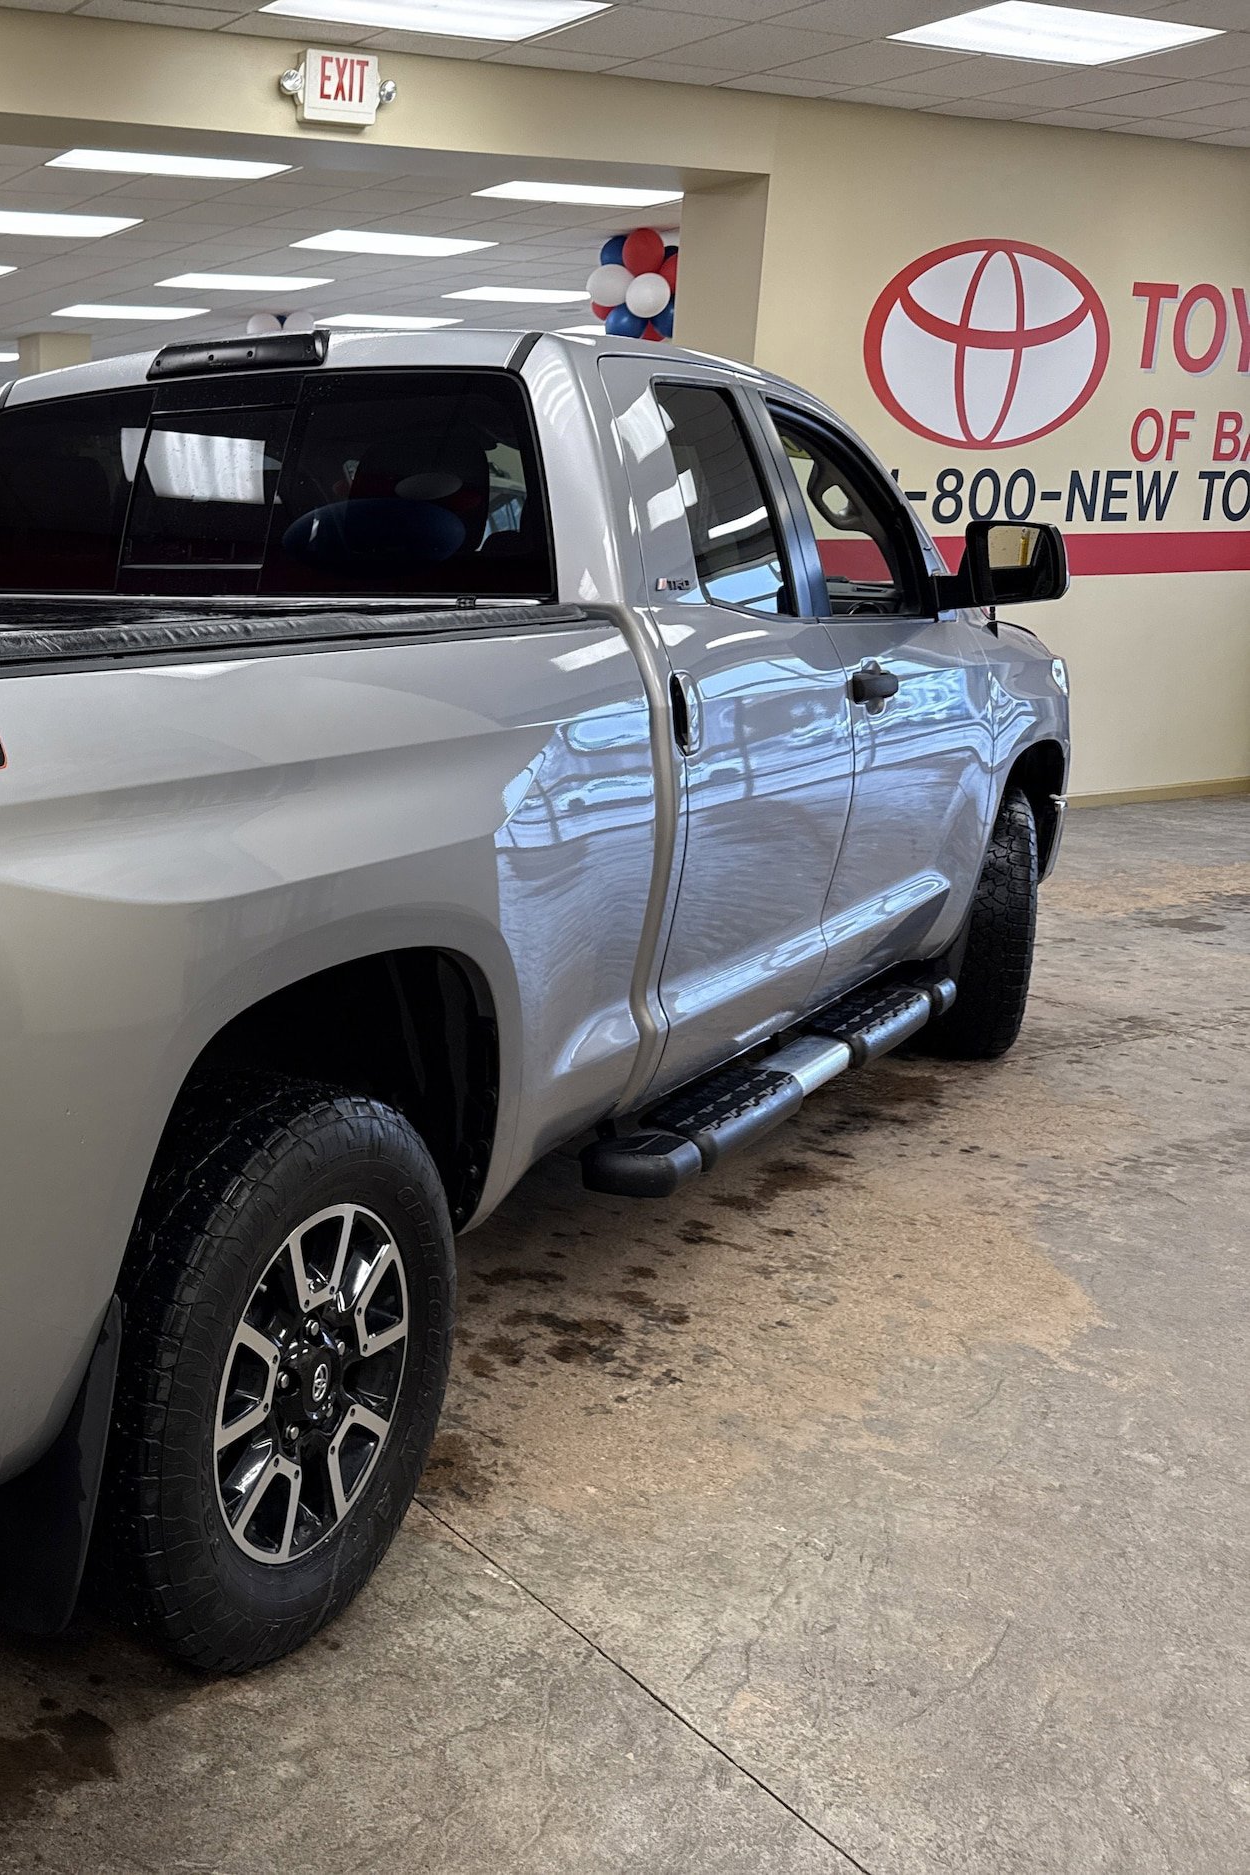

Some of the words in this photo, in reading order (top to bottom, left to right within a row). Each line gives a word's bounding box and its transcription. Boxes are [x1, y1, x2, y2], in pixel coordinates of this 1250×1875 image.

[319, 55, 369, 103] EXIT
[1130, 408, 1196, 463] OF
[1212, 411, 1250, 463] B
[1198, 469, 1250, 523] TO
